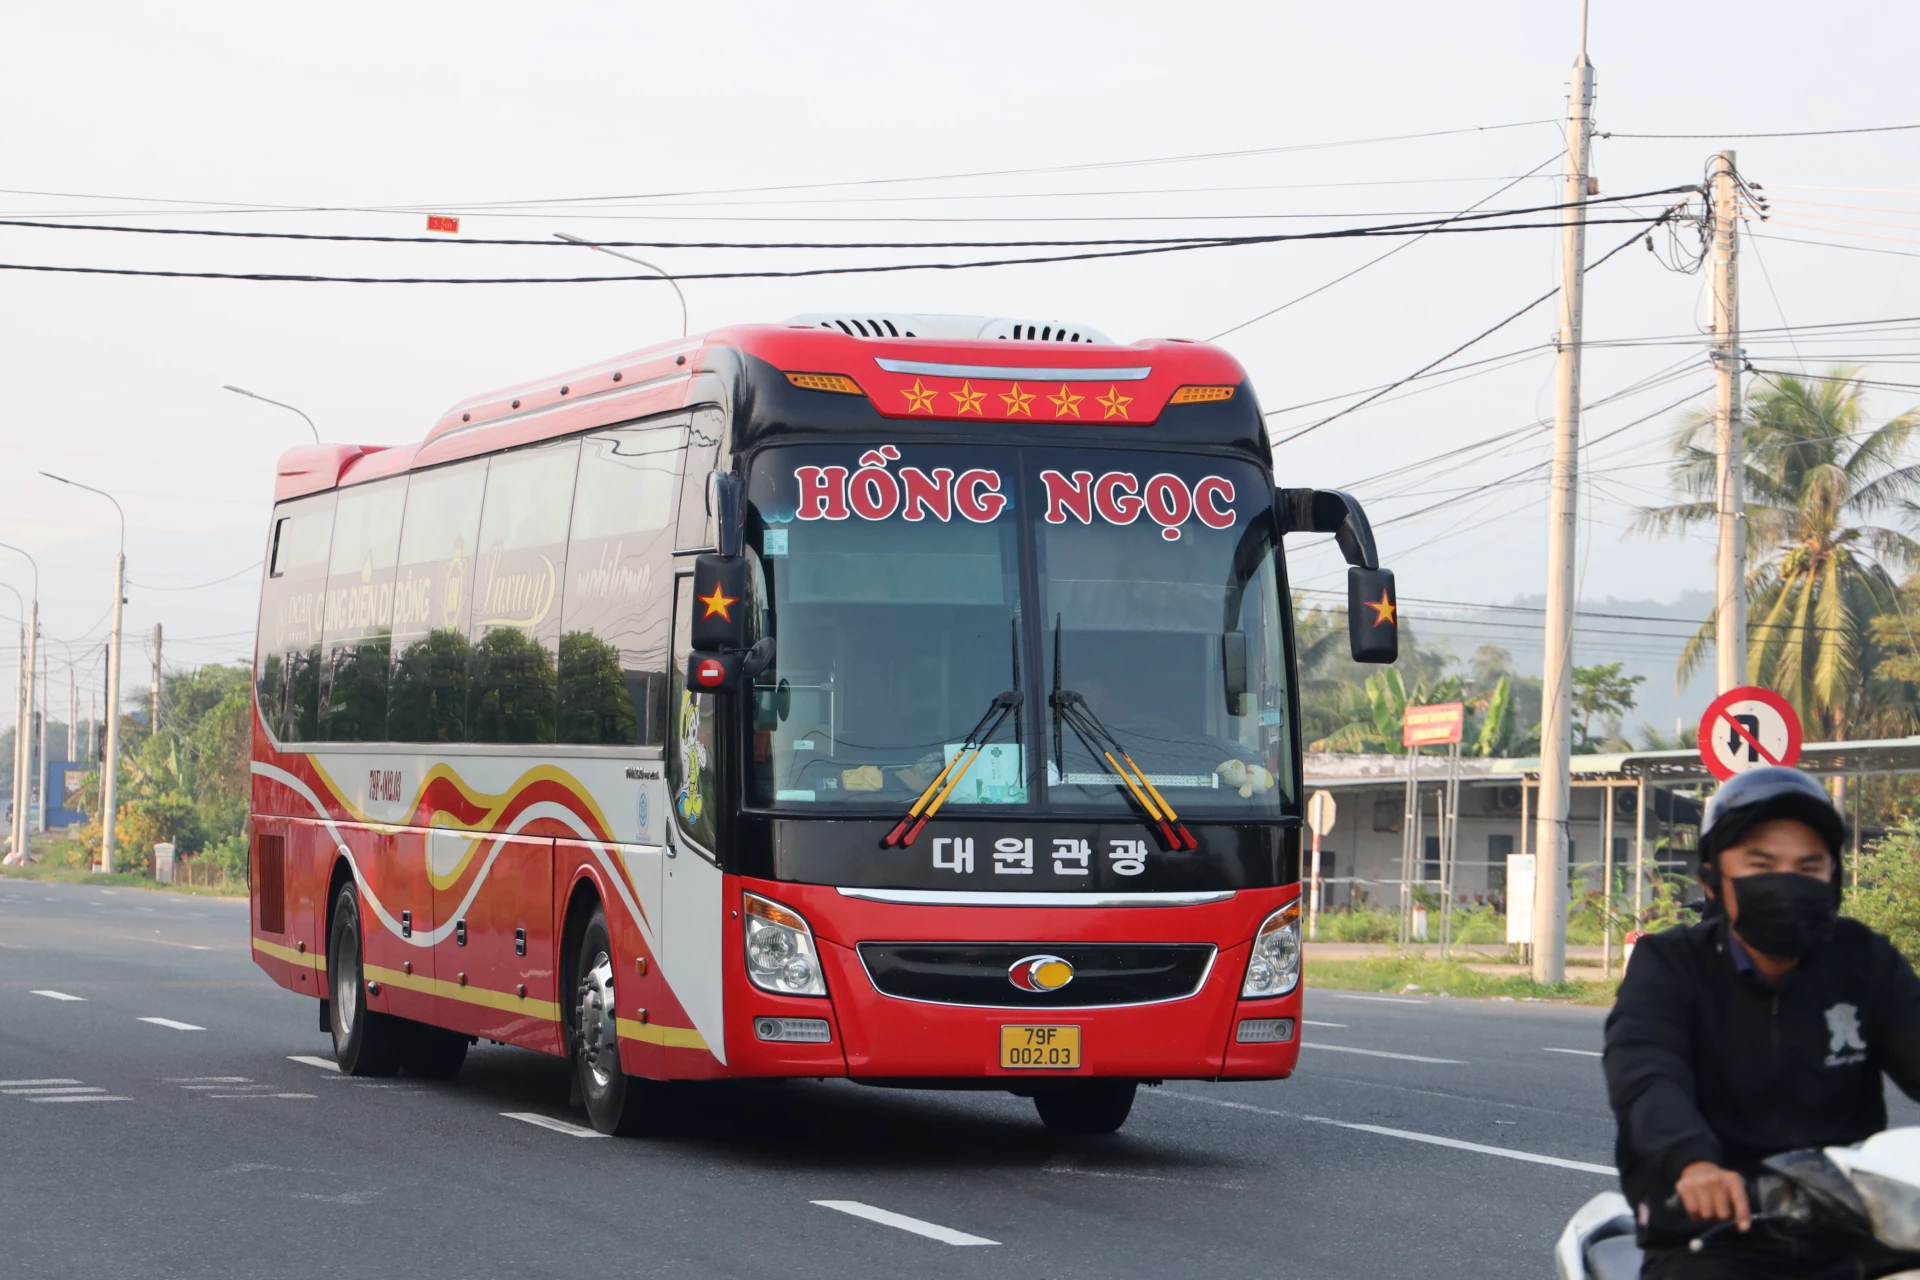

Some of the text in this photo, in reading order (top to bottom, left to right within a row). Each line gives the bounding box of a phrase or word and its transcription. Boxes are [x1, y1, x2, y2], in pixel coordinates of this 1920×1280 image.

[795, 445, 1237, 541] HỒNG NGỌC
[315, 588, 347, 632] CUNG
[1024, 1028, 1057, 1045] 79F
[1009, 1047, 1071, 1065] 002.03
